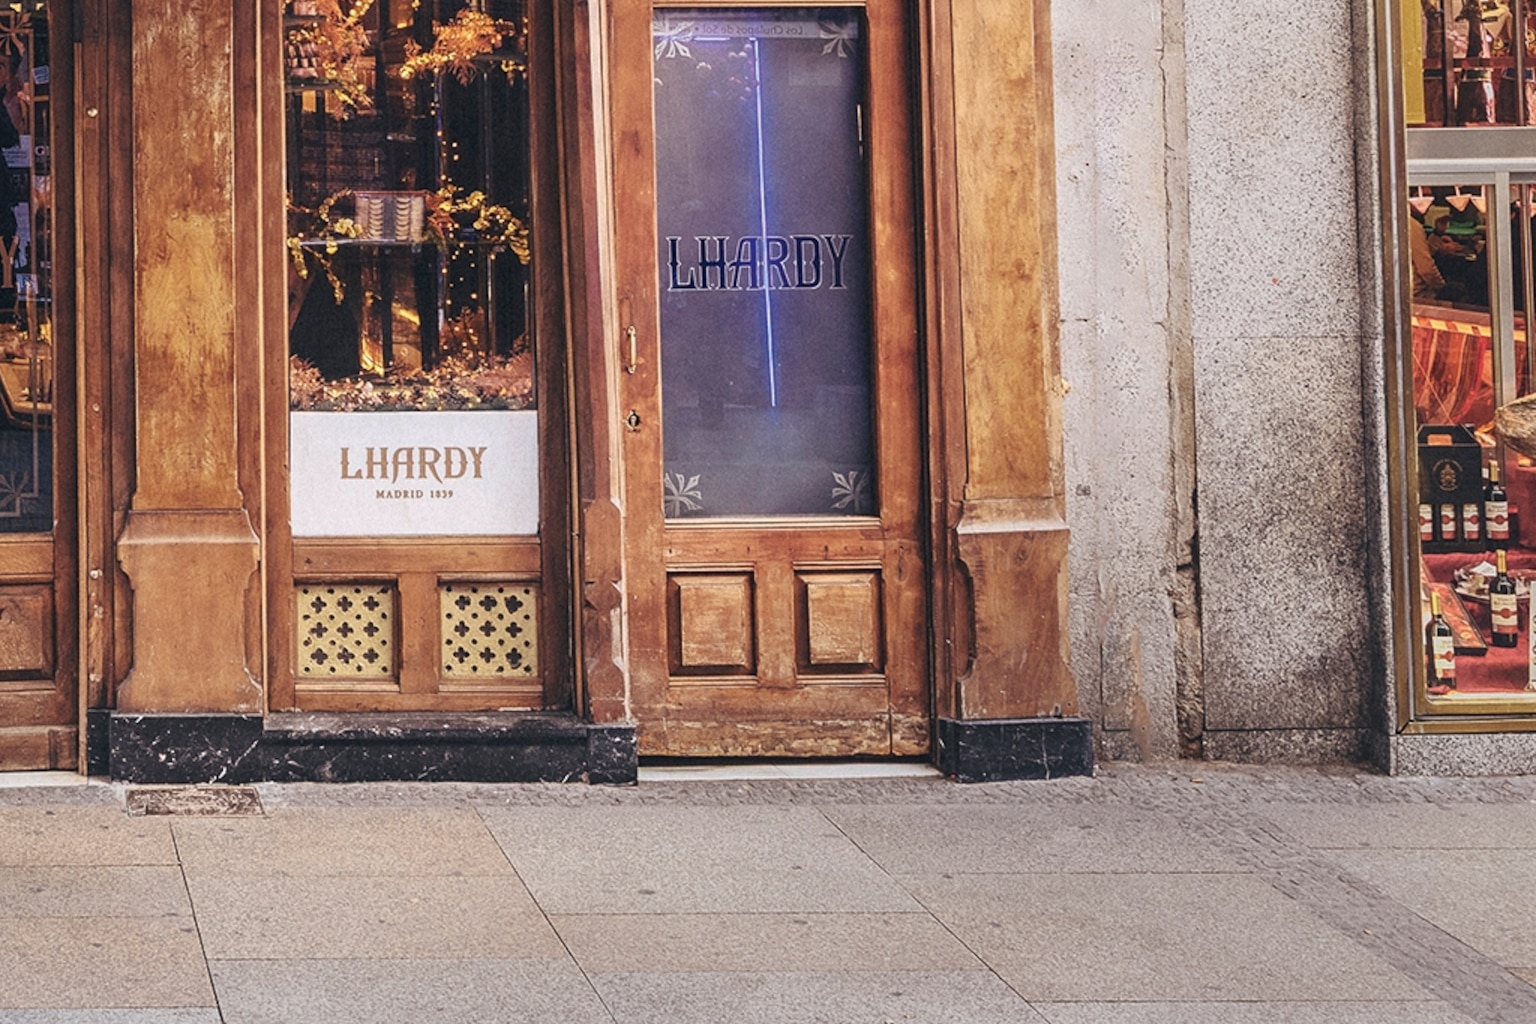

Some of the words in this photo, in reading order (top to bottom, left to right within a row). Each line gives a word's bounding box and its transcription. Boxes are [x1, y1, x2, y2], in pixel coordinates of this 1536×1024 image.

[665, 234, 854, 293] LHARDY
[340, 445, 488, 485] LHARDY
[375, 490, 424, 499] MADRID
[429, 490, 454, 499] 1839
